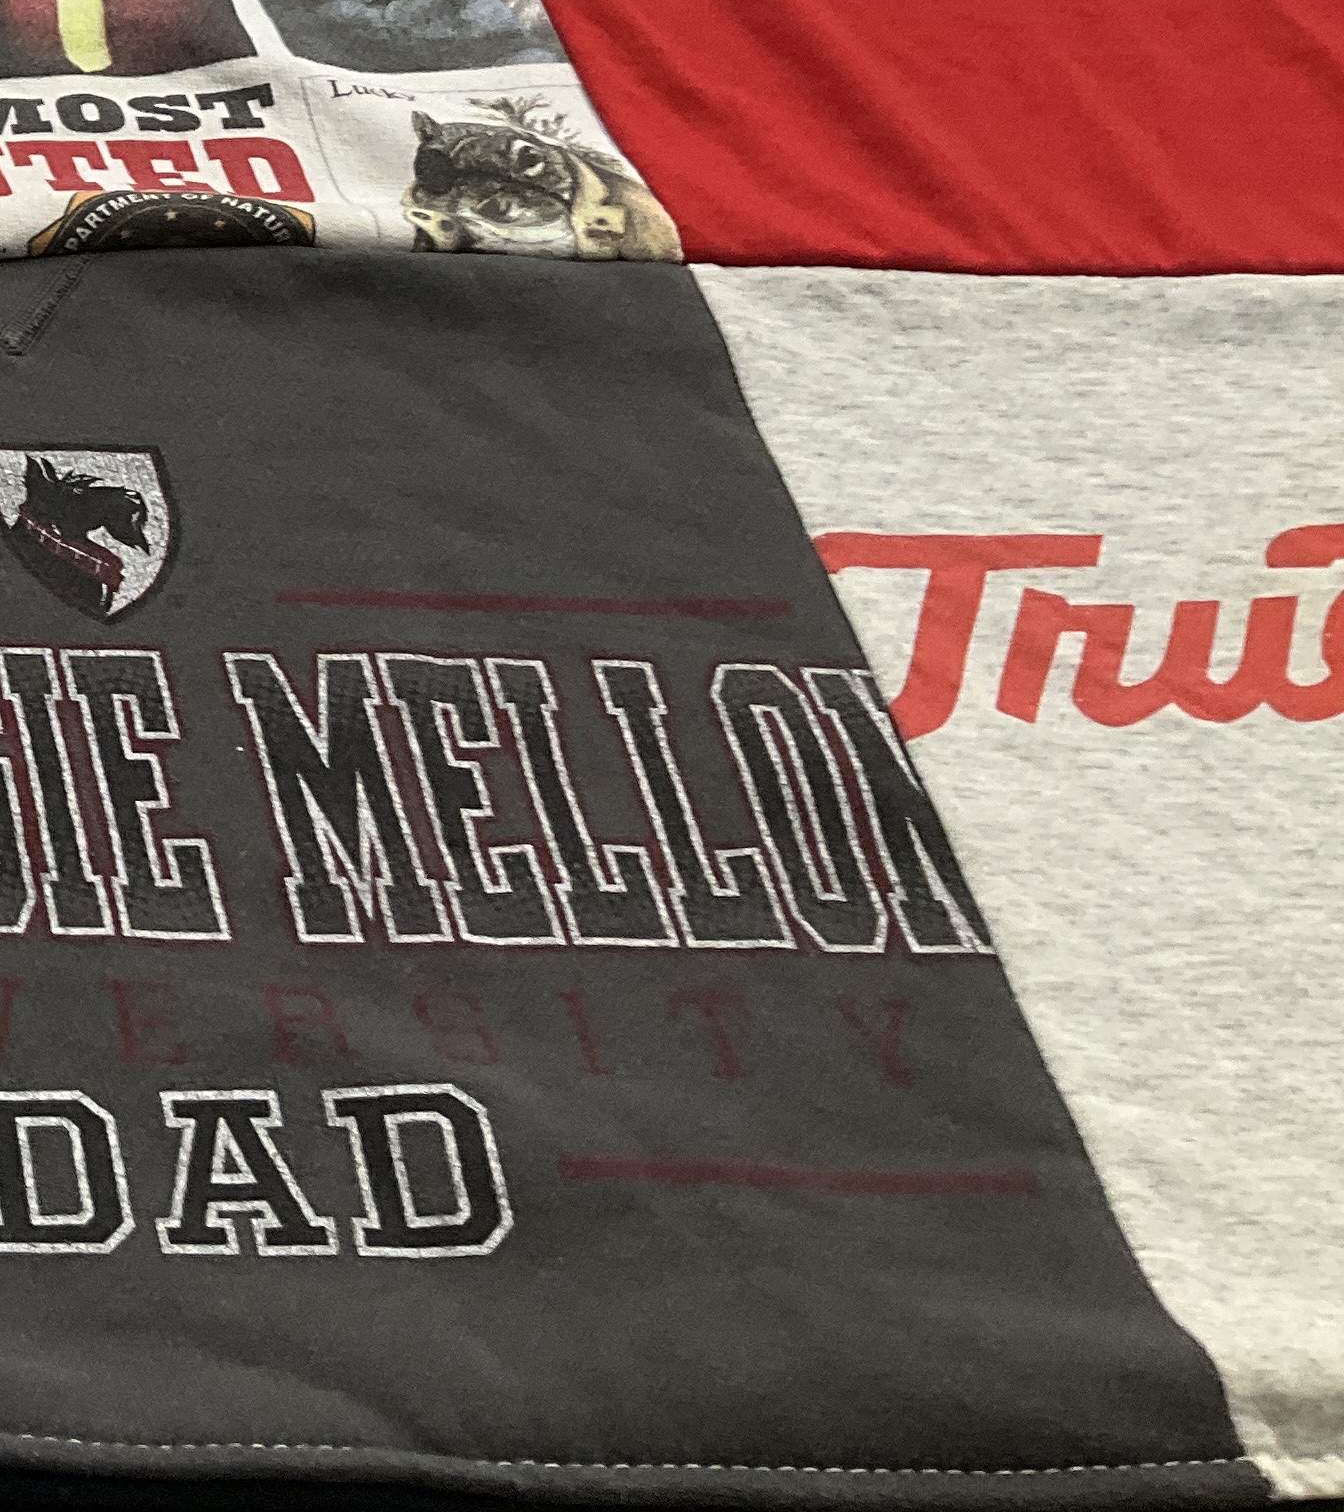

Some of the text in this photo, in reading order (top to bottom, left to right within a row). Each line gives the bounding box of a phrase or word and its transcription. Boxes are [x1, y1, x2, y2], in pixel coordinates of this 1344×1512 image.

[328, 79, 417, 102] Lucky
[63, 193, 172, 251] PARTMENT
[812, 523, 1344, 743] Tru
[221, 648, 996, 957] MELLON
